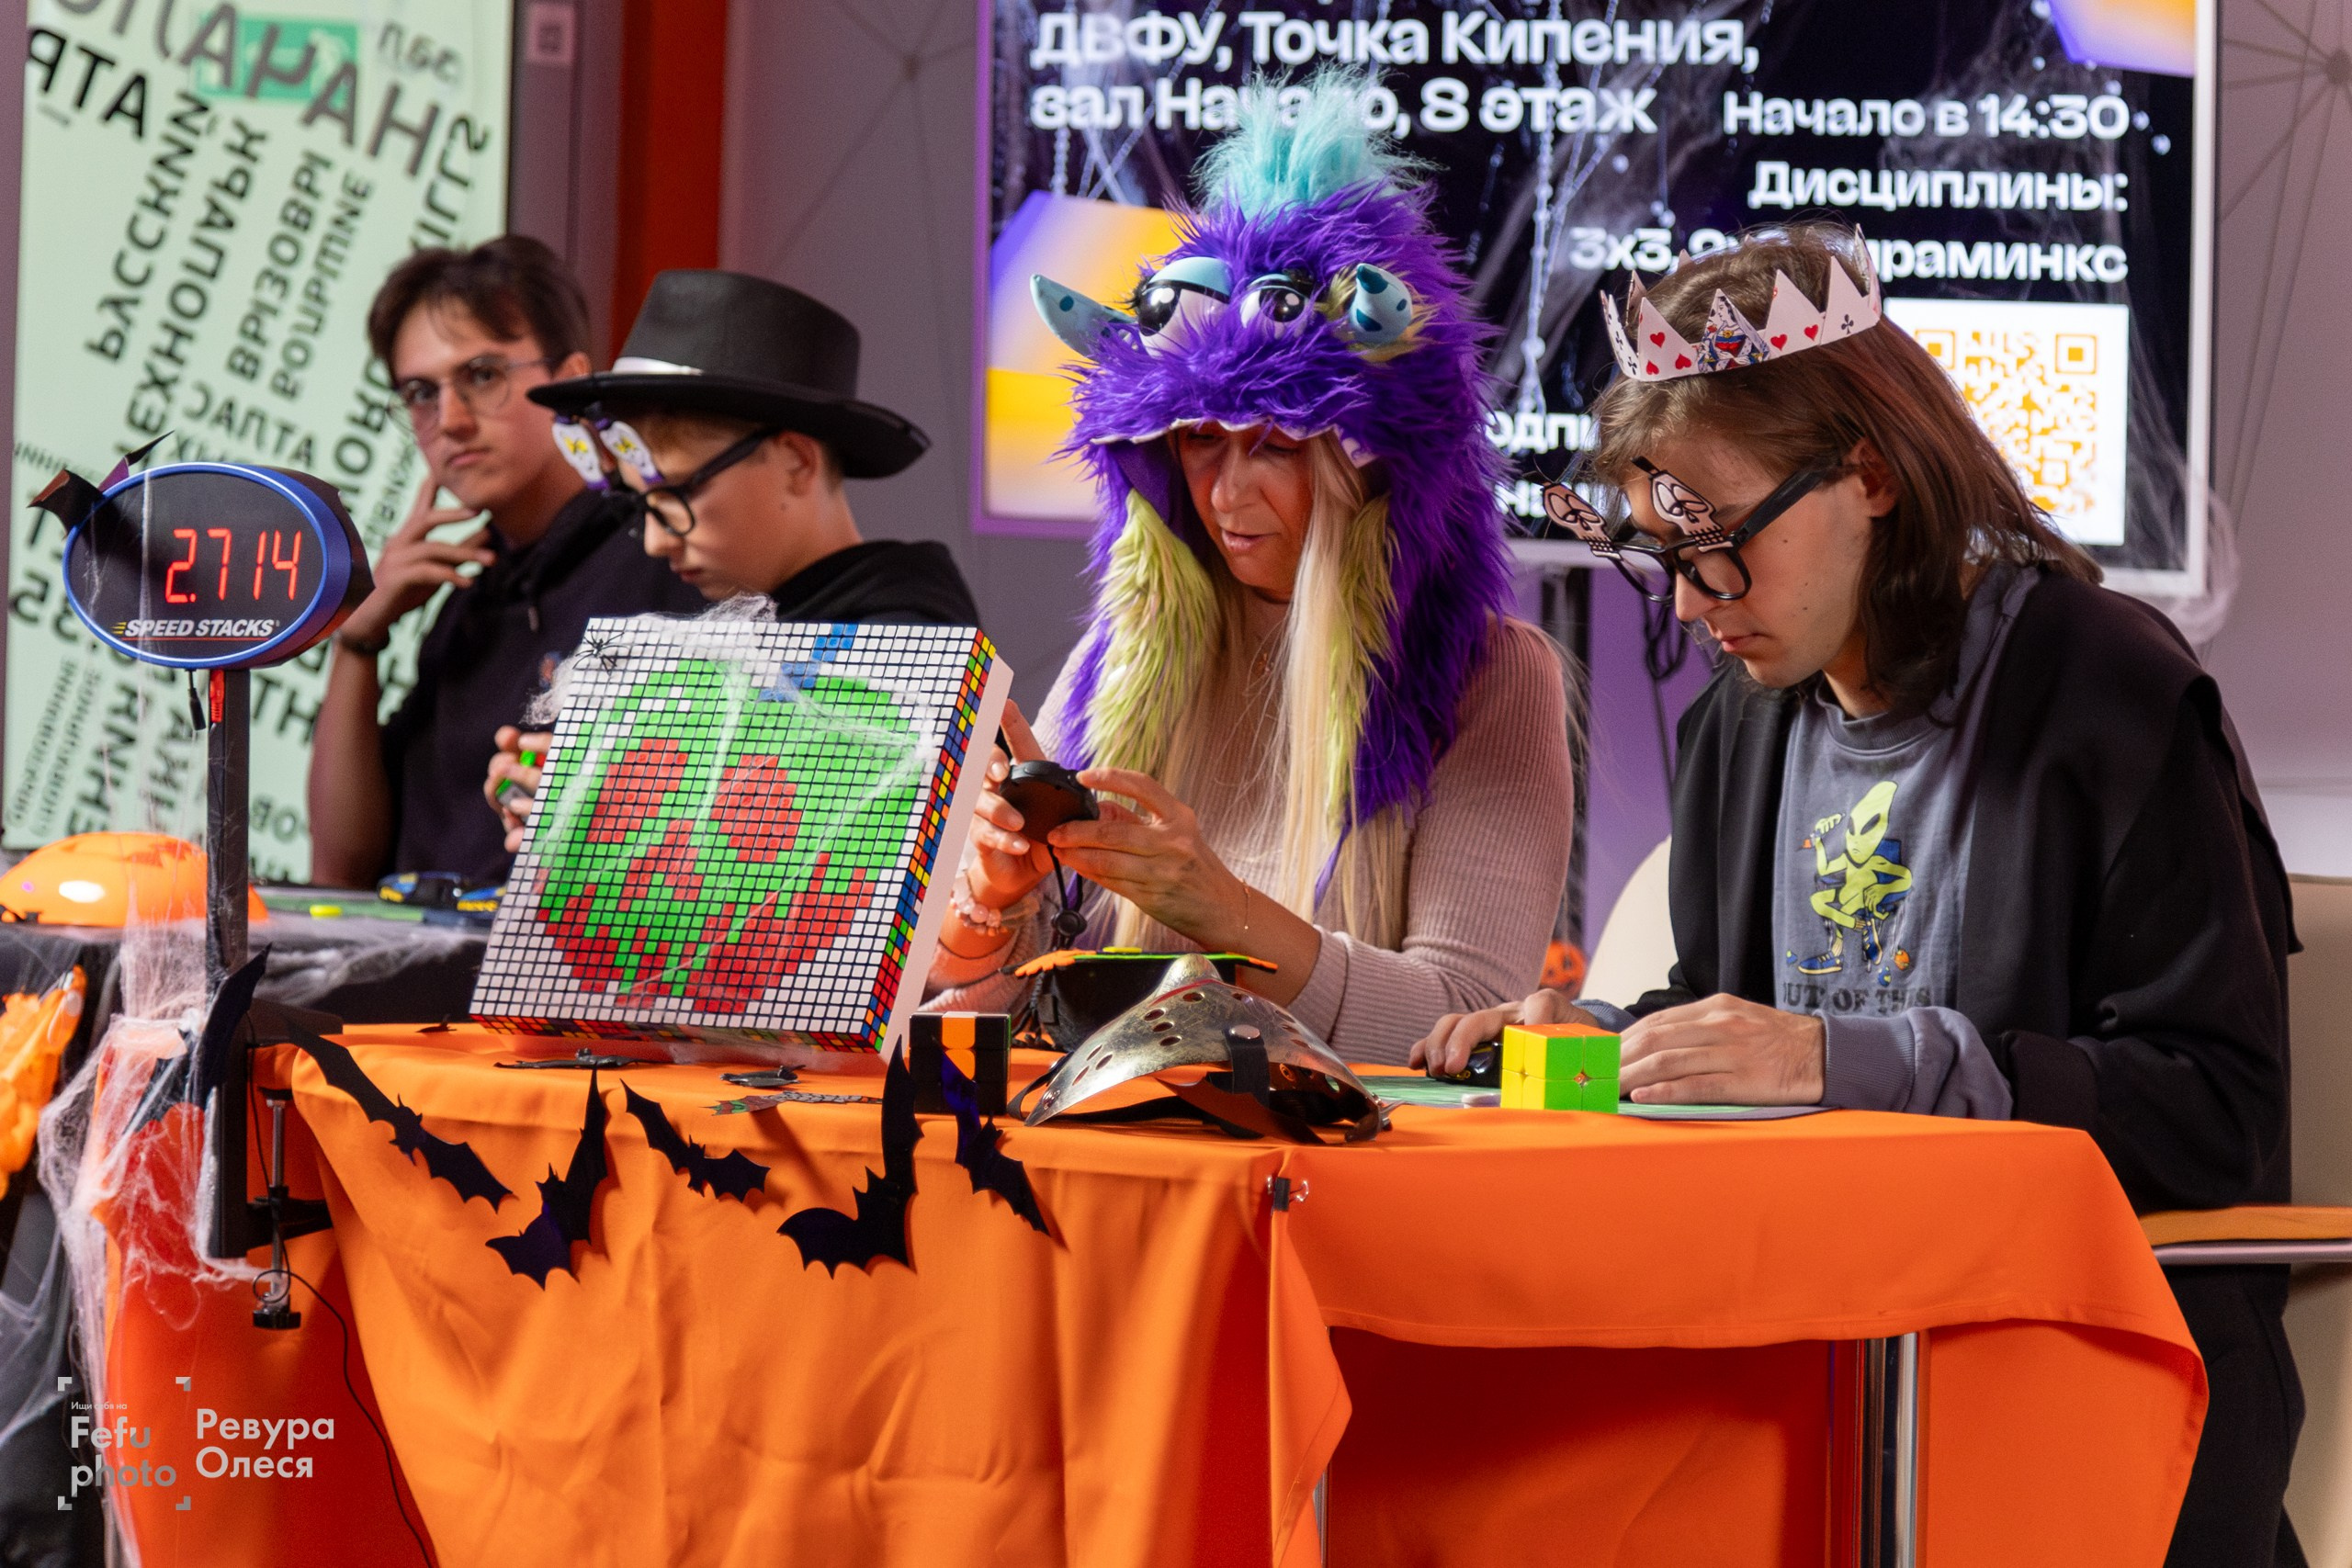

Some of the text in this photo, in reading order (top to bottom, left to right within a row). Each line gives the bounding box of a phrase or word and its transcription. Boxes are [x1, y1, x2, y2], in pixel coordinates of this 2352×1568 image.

[1030, 10, 1759, 73] ДВФУ, Точка Кипения,
[1031, 77, 1659, 139] зал Наао, 8 этаж
[1724, 91, 2131, 140] Начало в 14:30
[1747, 160, 2129, 211] Дисциплины:
[1866, 239, 2128, 282] раминкс
[165, 528, 301, 603] 2.714
[125, 618, 276, 637] SPEED STACKS
[1783, 982, 1826, 1009] UT
[1833, 987, 1868, 1010] OF
